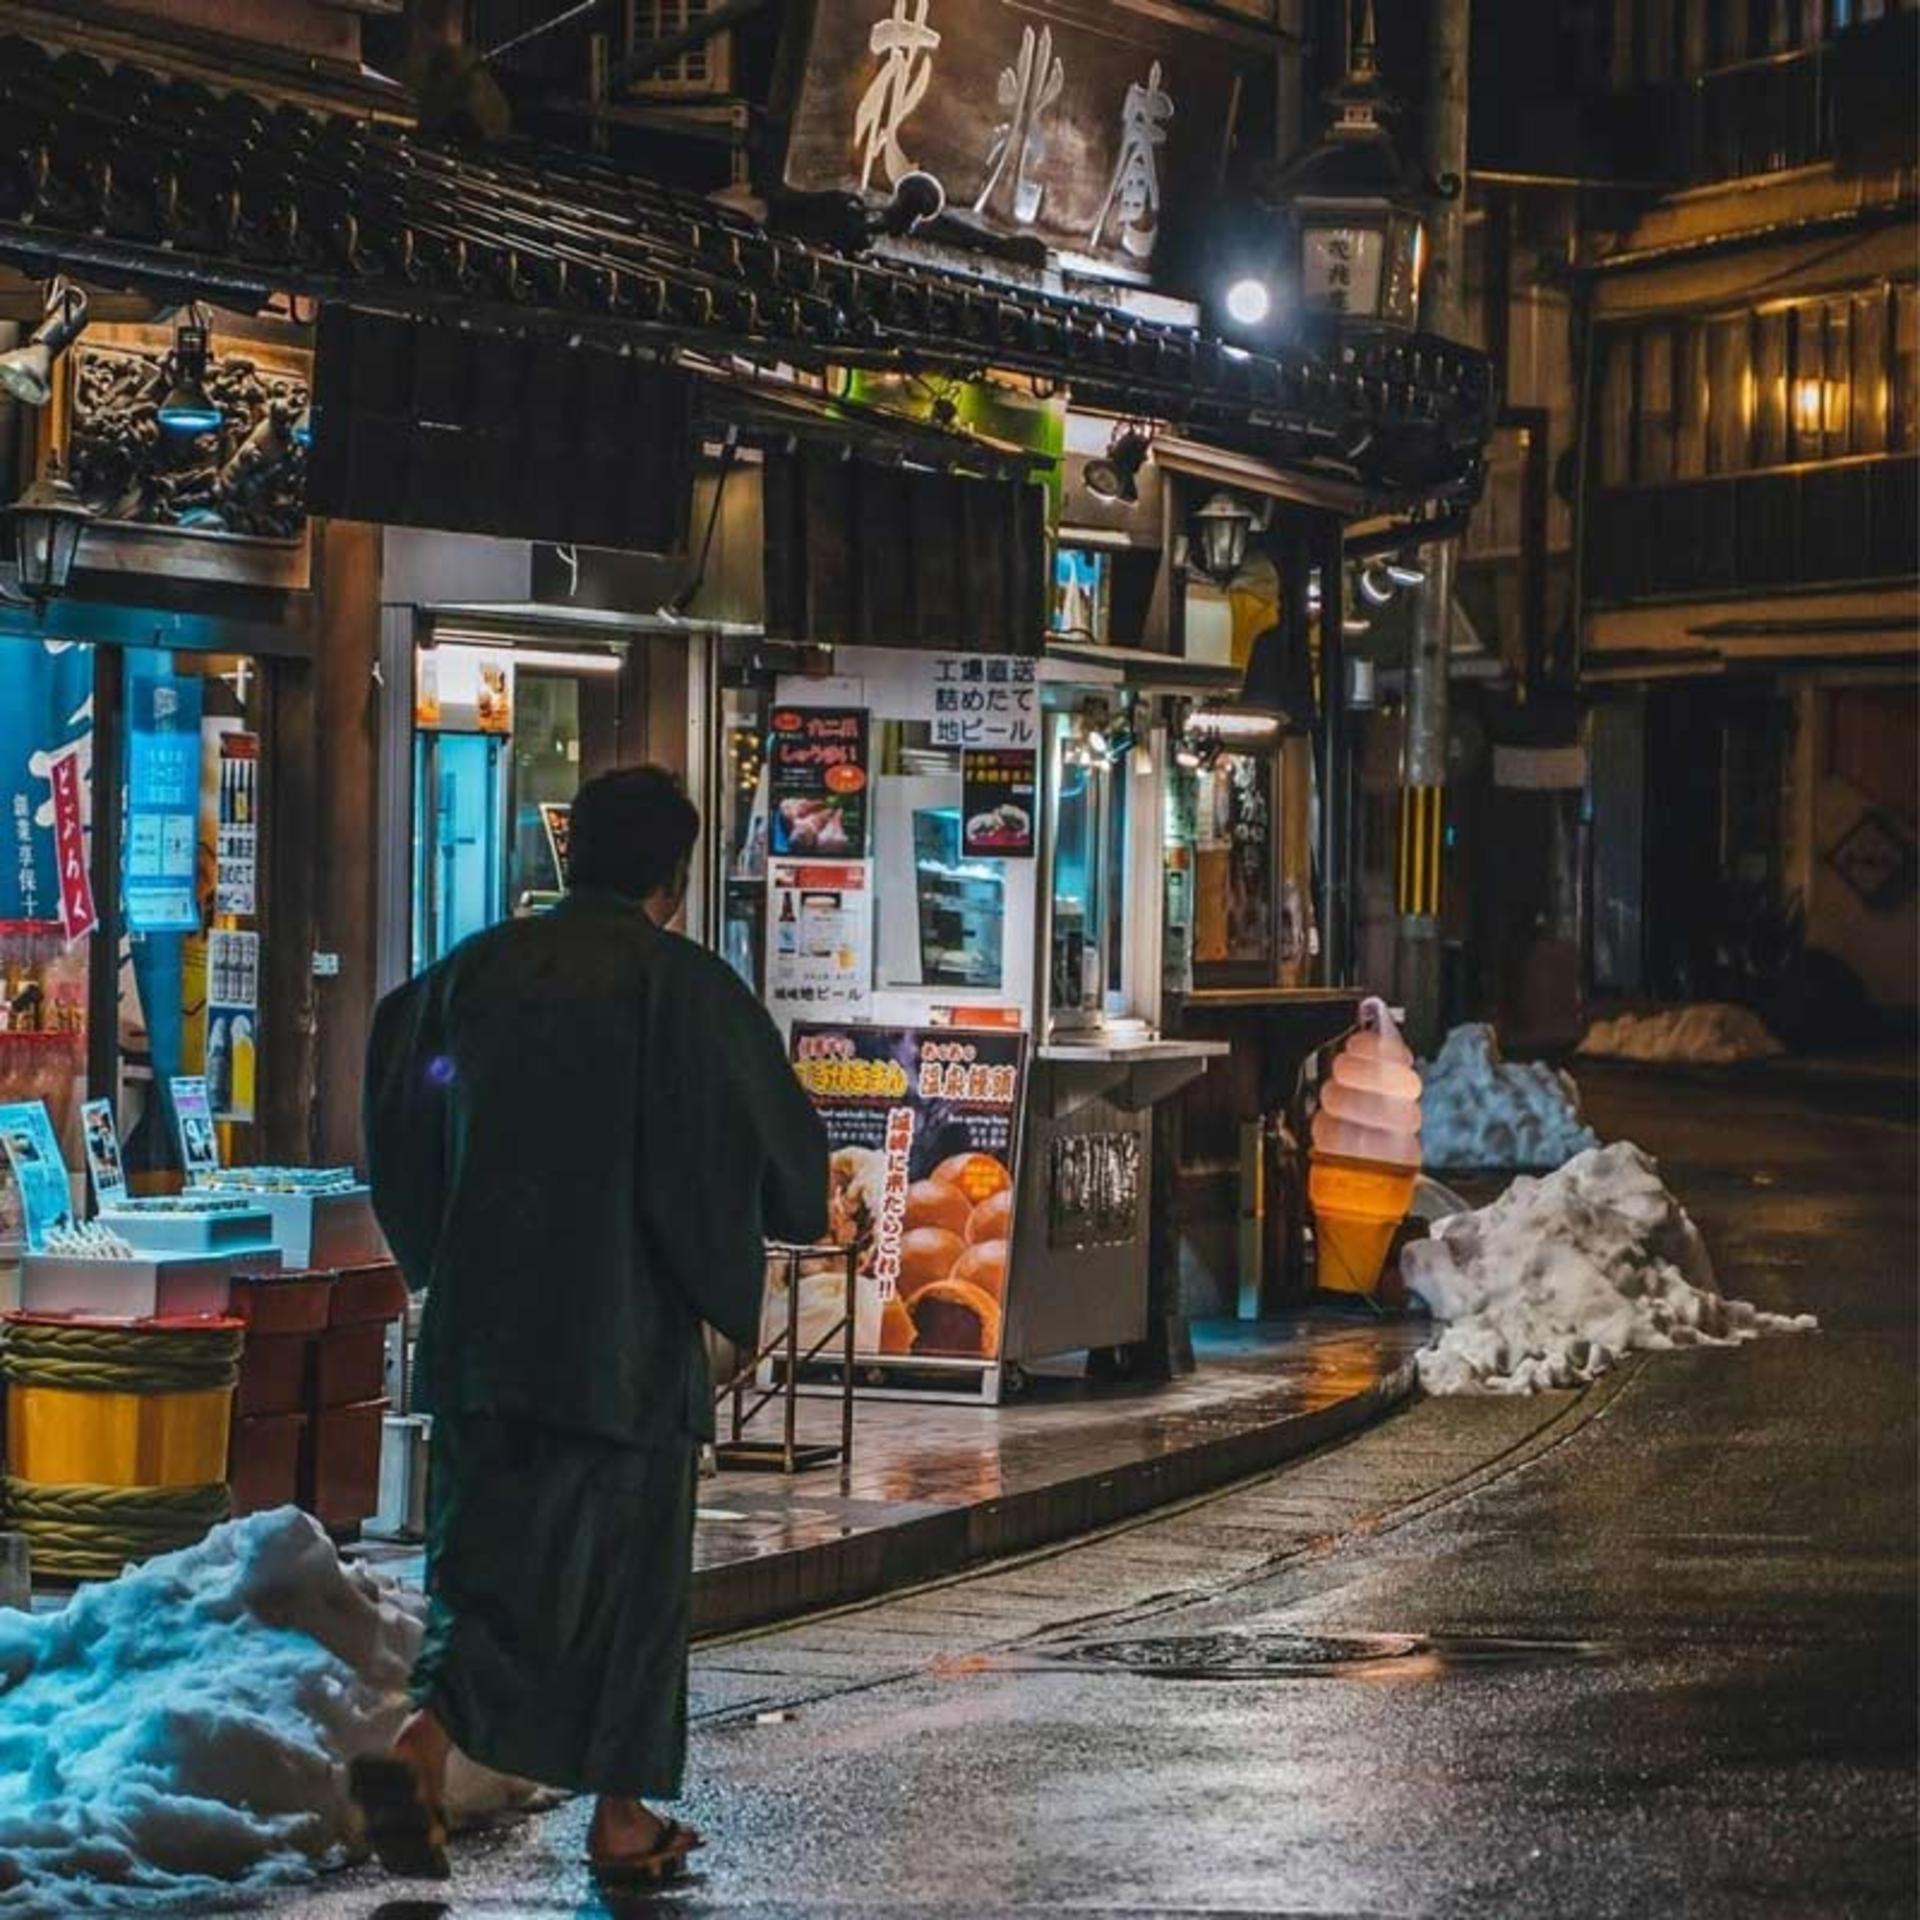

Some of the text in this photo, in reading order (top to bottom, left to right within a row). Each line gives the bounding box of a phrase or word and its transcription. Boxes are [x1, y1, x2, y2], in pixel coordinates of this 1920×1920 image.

[934, 659, 1035, 681] 工場直送
[935, 687, 1034, 712] 詰めたて
[936, 717, 1034, 742] 地ビール
